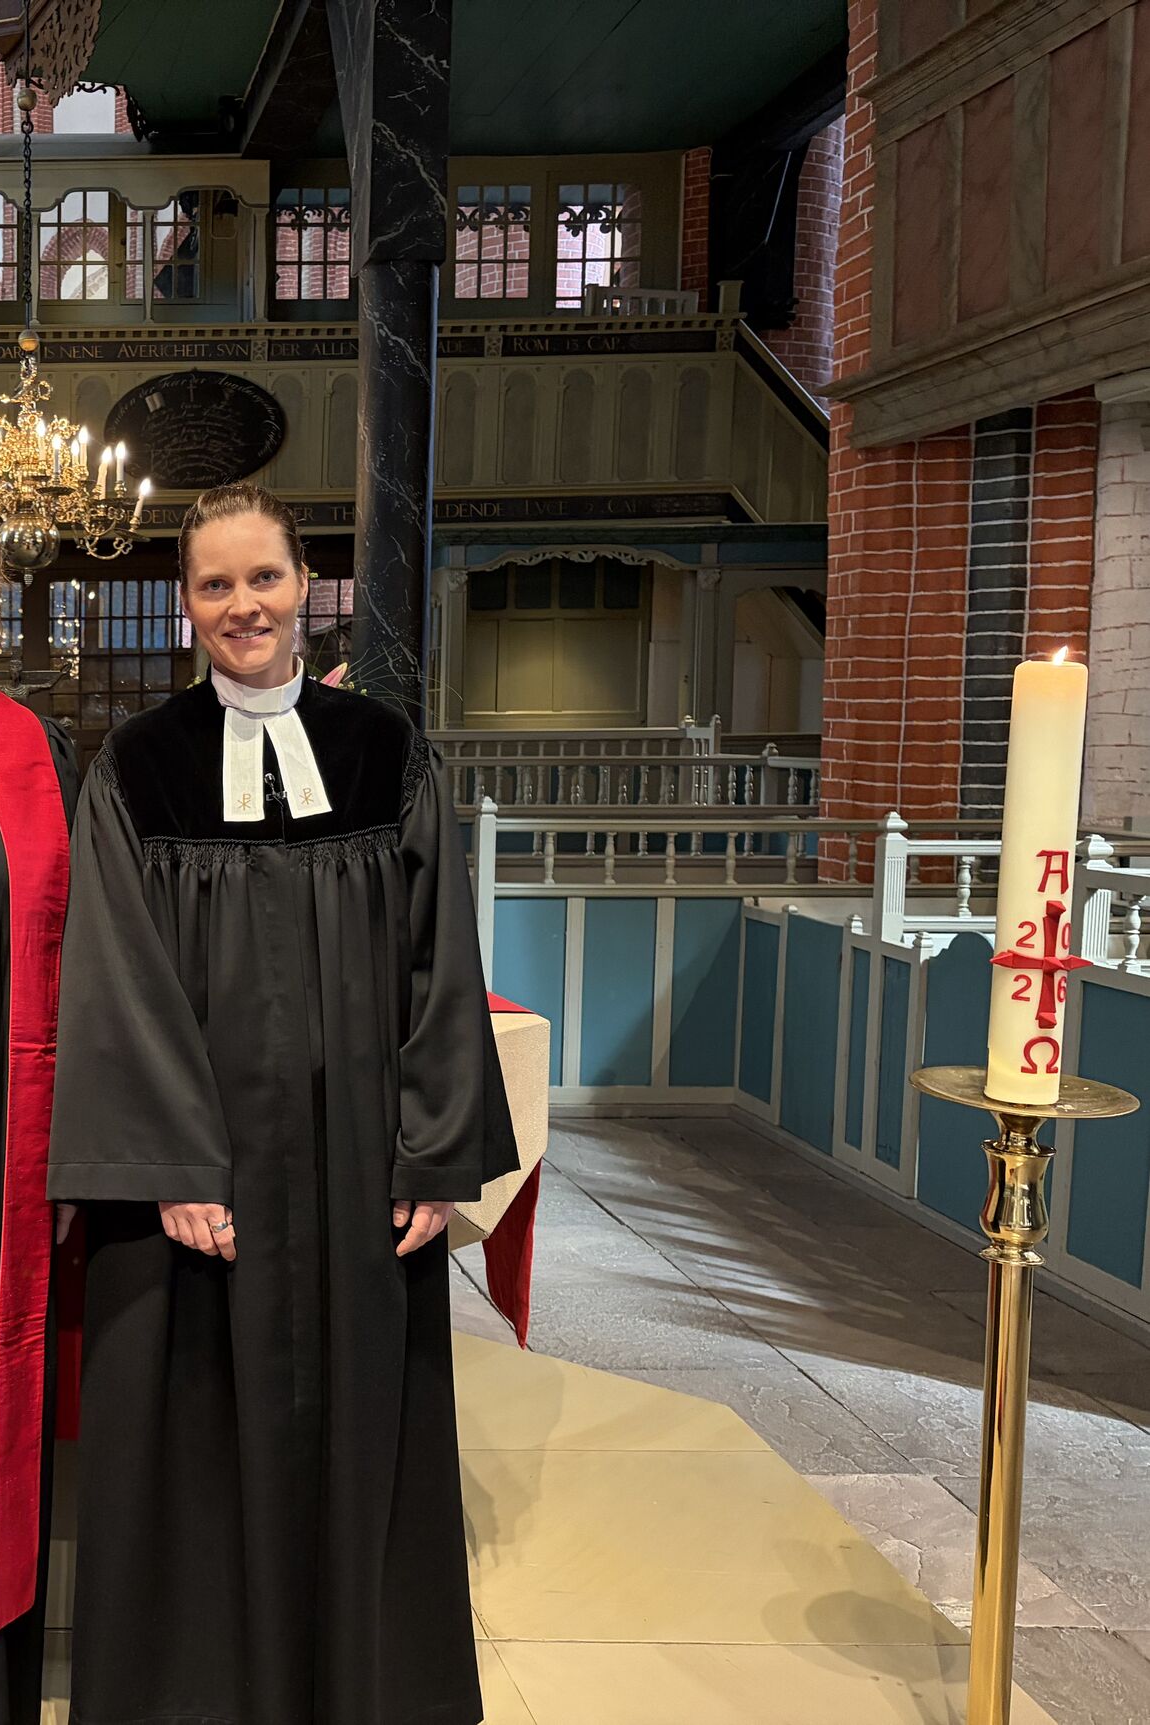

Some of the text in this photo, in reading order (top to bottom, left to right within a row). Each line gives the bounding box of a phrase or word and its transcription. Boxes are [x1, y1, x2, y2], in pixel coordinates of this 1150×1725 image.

[43, 346, 55, 359] IS
[60, 346, 104, 359] NENE
[217, 342, 250, 358] SVN
[271, 342, 300, 356] DER
[1020, 1036, 1060, 1074] Ω
